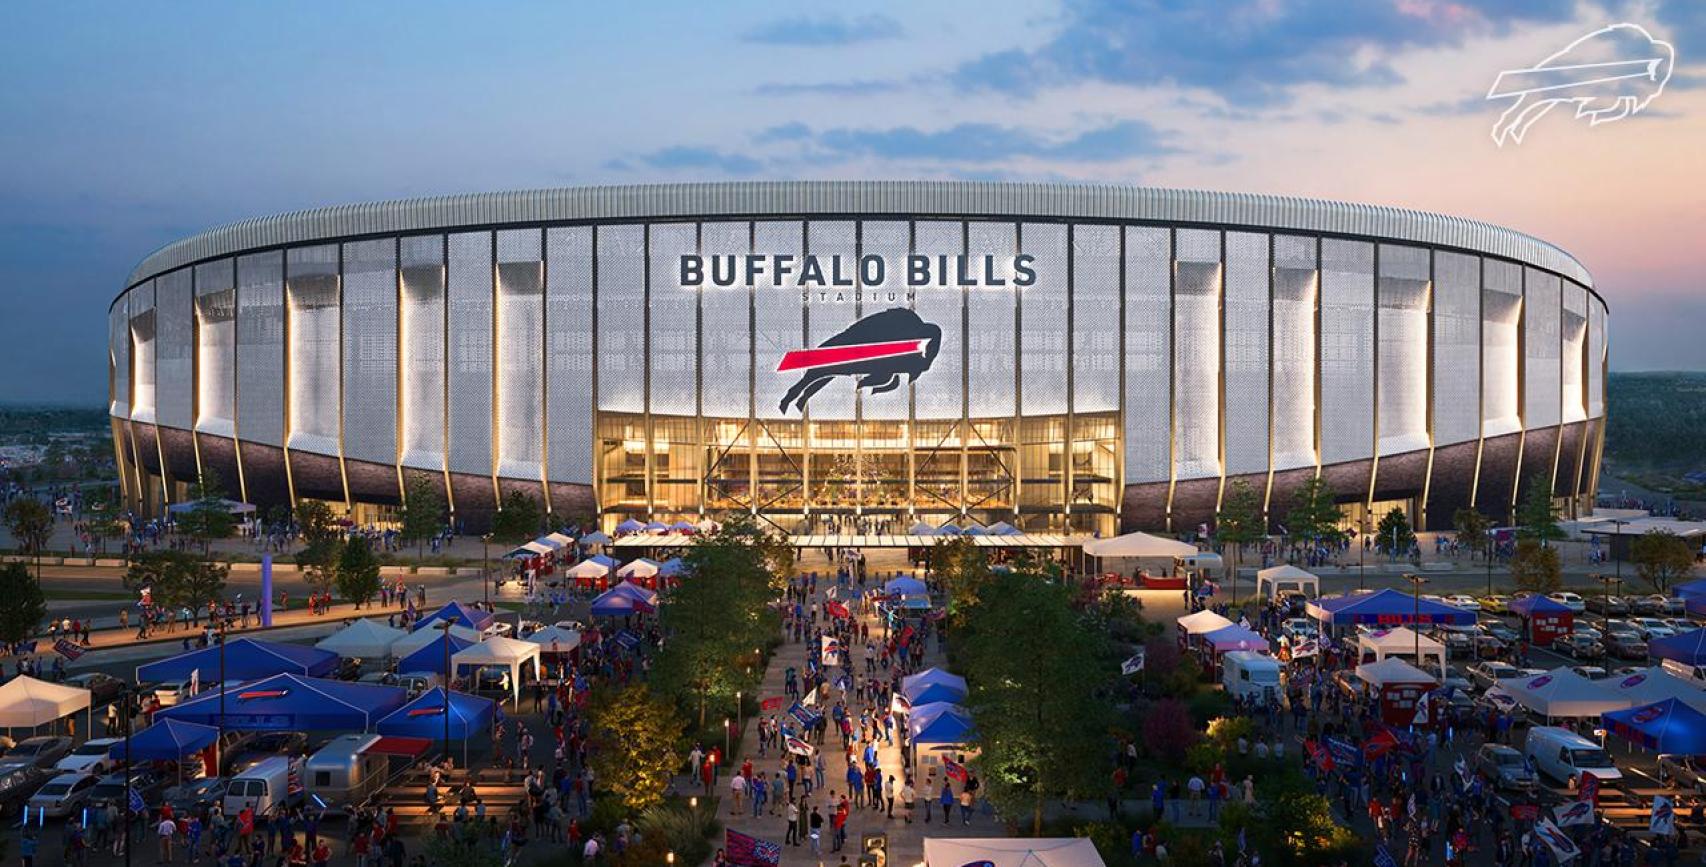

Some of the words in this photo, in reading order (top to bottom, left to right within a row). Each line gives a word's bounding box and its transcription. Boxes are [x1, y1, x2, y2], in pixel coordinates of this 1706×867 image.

[681, 255, 885, 286] BUFFALO
[908, 254, 1037, 286] BILLS
[802, 292, 915, 302] STADIUM
